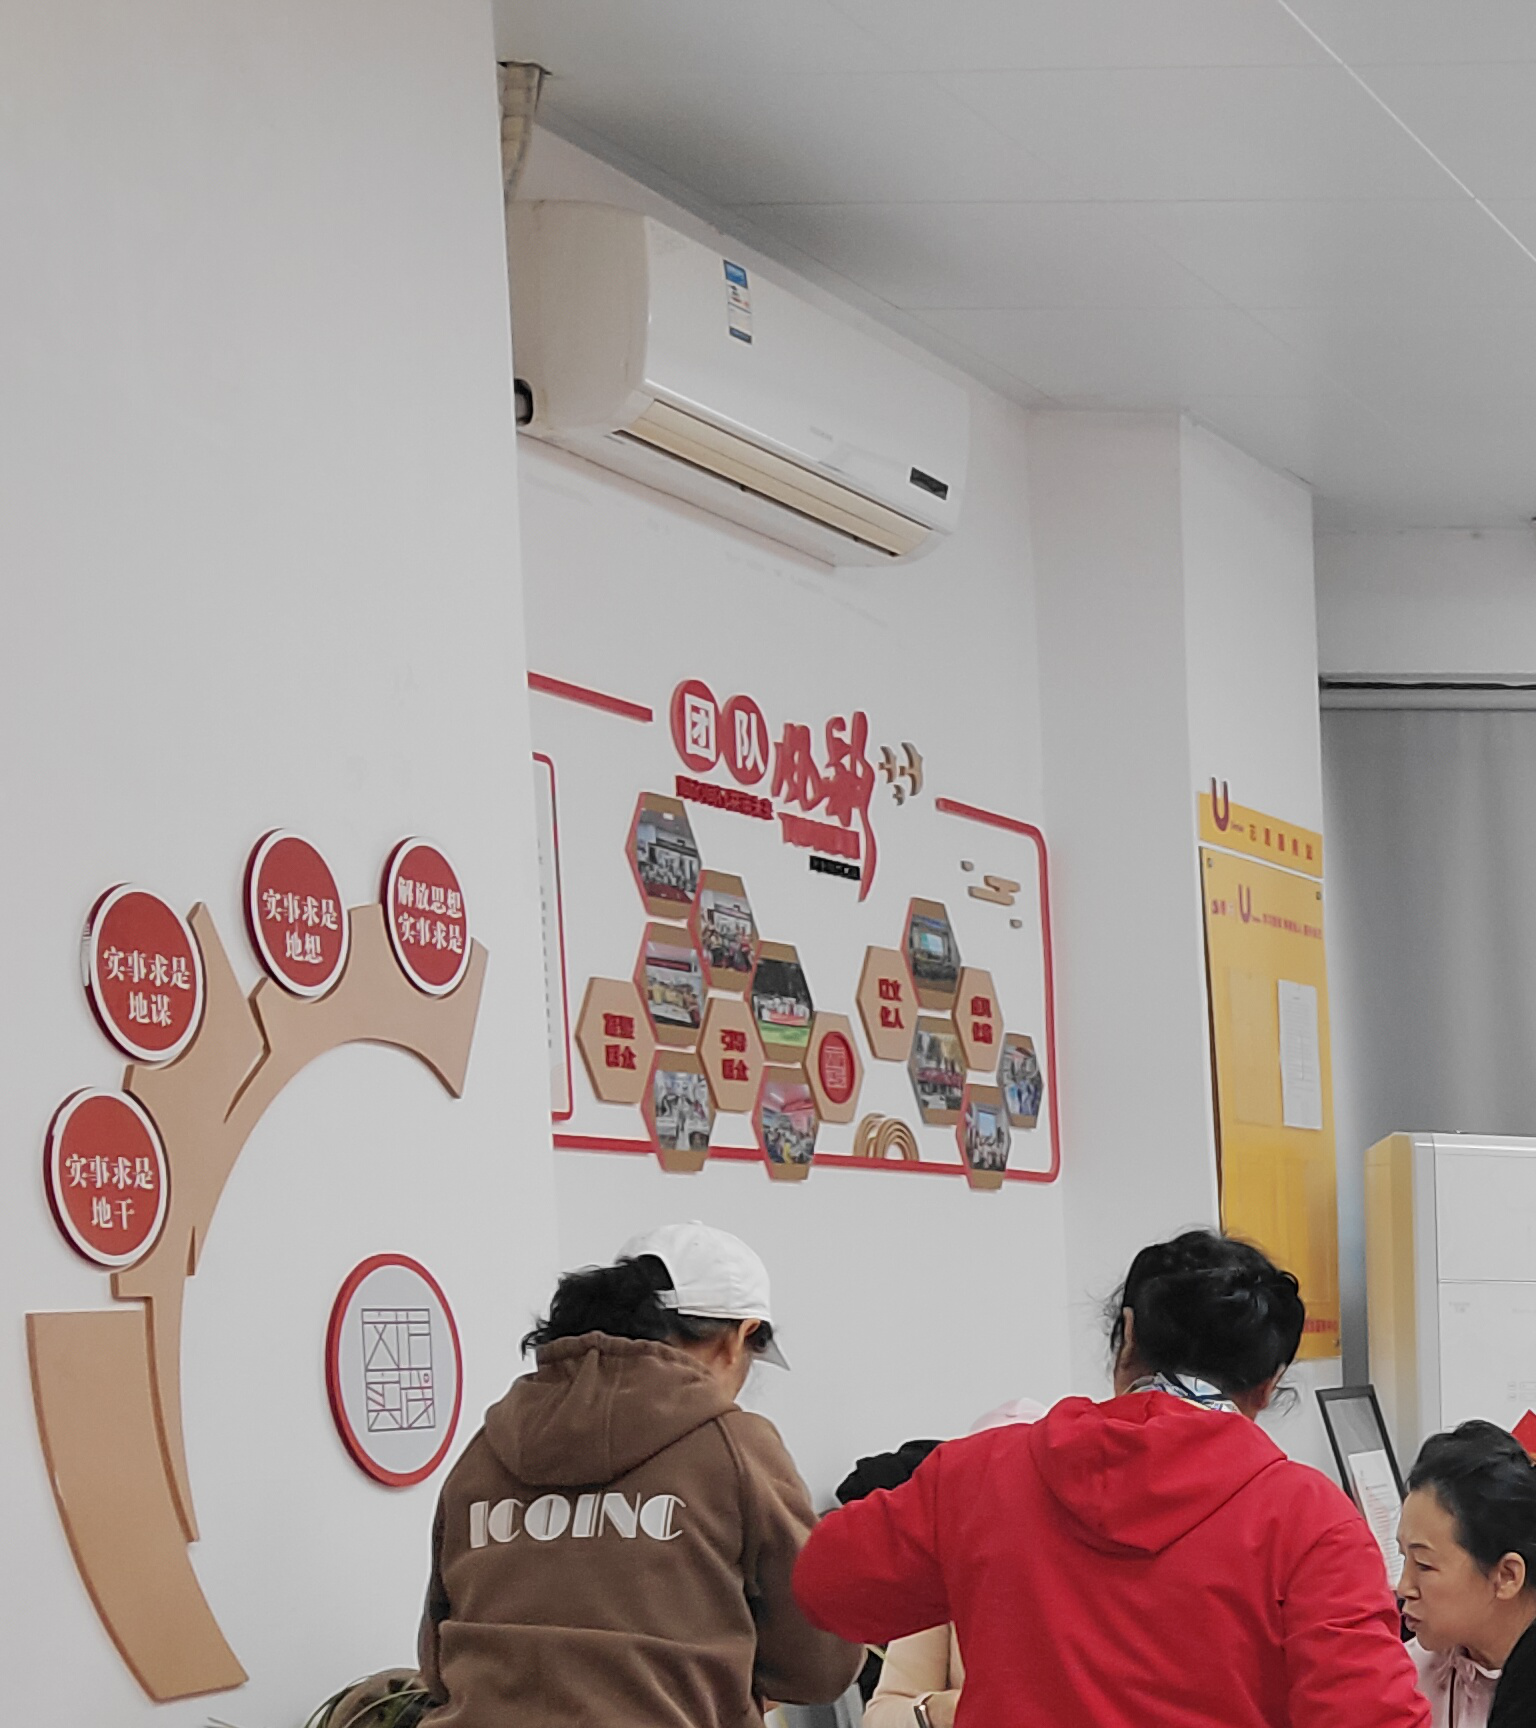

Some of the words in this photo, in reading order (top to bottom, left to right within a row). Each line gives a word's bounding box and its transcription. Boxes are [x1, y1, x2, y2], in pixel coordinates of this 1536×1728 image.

[262, 889, 339, 931] 实事求是
[398, 876, 463, 920] 解放思想
[284, 932, 323, 965] 地想
[398, 913, 463, 956] 实事求是
[102, 945, 191, 991] 实事求是
[128, 992, 172, 1028] 地谋
[65, 1153, 155, 1191] 实事求是
[91, 1198, 135, 1231] 地干
